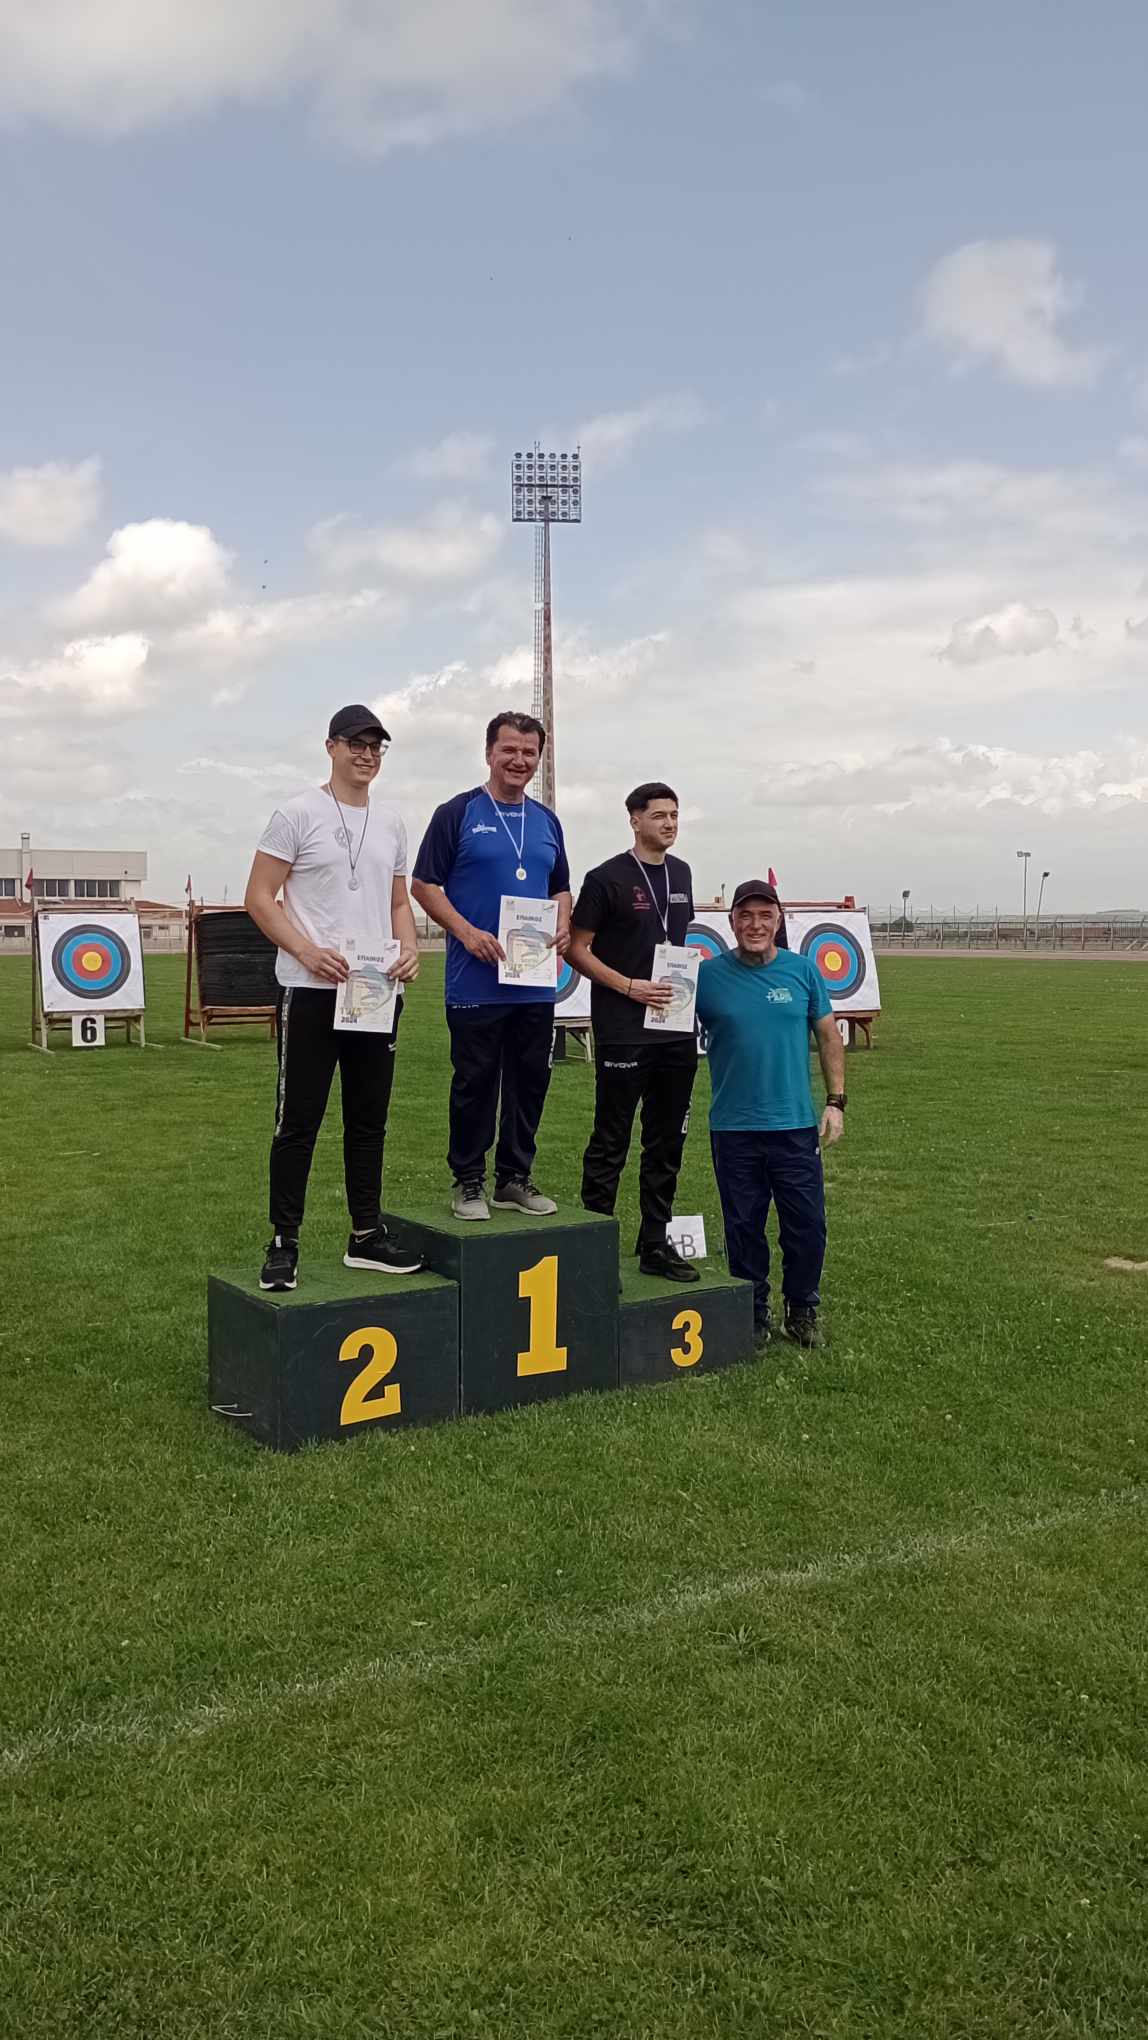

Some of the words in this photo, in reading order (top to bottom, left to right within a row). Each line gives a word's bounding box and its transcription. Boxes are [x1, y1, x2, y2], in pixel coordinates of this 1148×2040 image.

[80, 1017, 98, 1044] 6
[516, 1255, 568, 1377] 1
[669, 1309, 704, 1368] 3
[338, 1326, 401, 1426] 2
